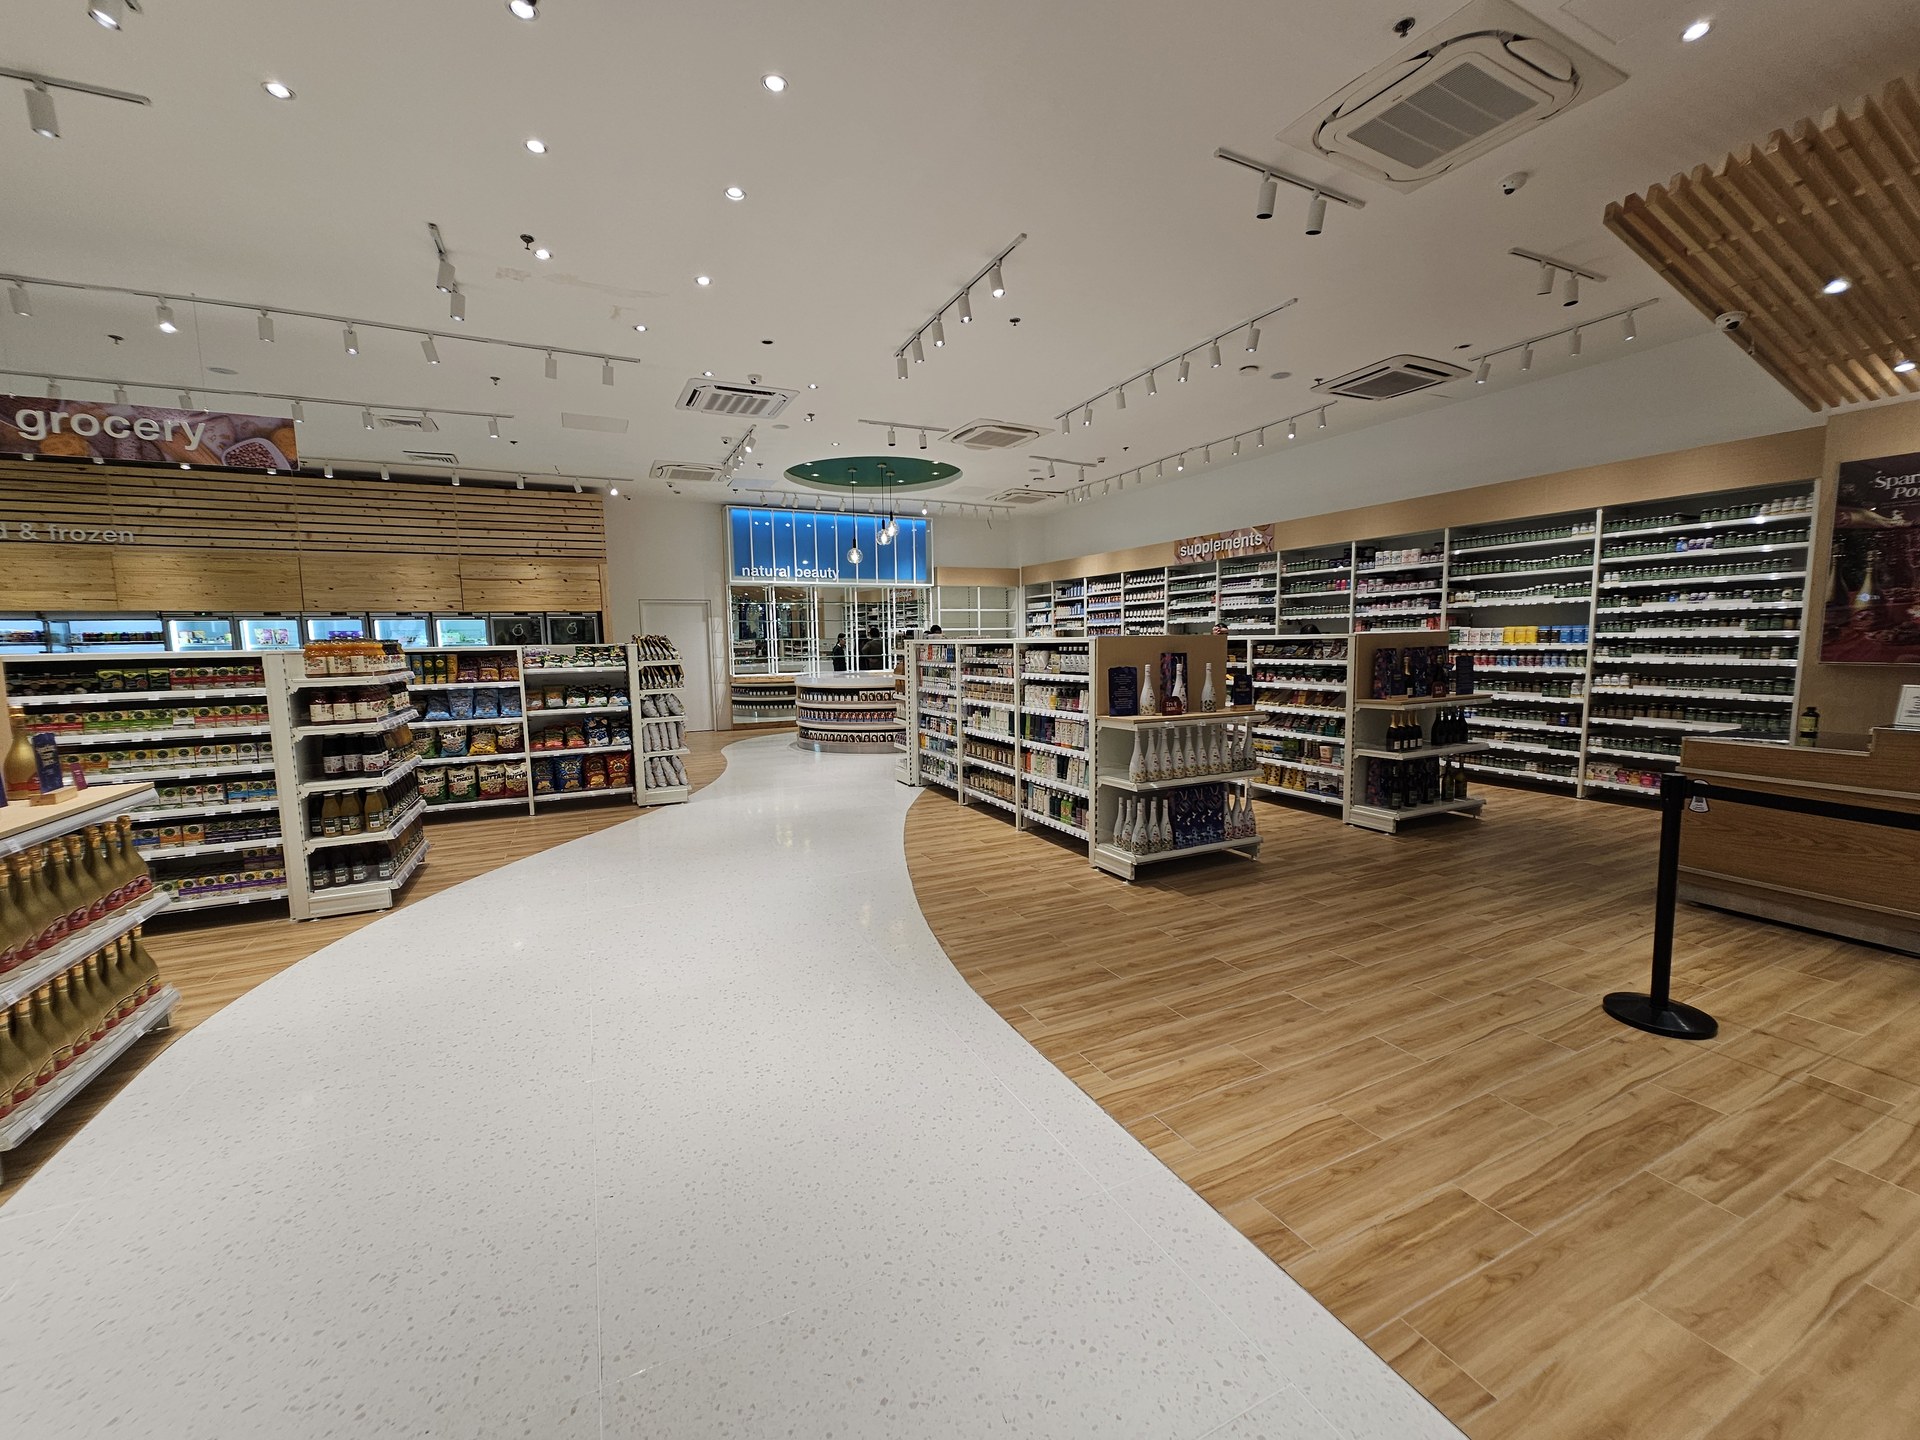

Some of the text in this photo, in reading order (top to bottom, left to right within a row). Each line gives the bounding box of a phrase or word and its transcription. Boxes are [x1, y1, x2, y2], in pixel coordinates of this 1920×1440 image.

[15, 407, 206, 451] grocery
[1891, 486, 1920, 499] Po
[19, 522, 40, 540] &
[48, 523, 135, 543] frozen
[1180, 531, 1263, 558] supplements
[742, 565, 840, 580] natural beauty
